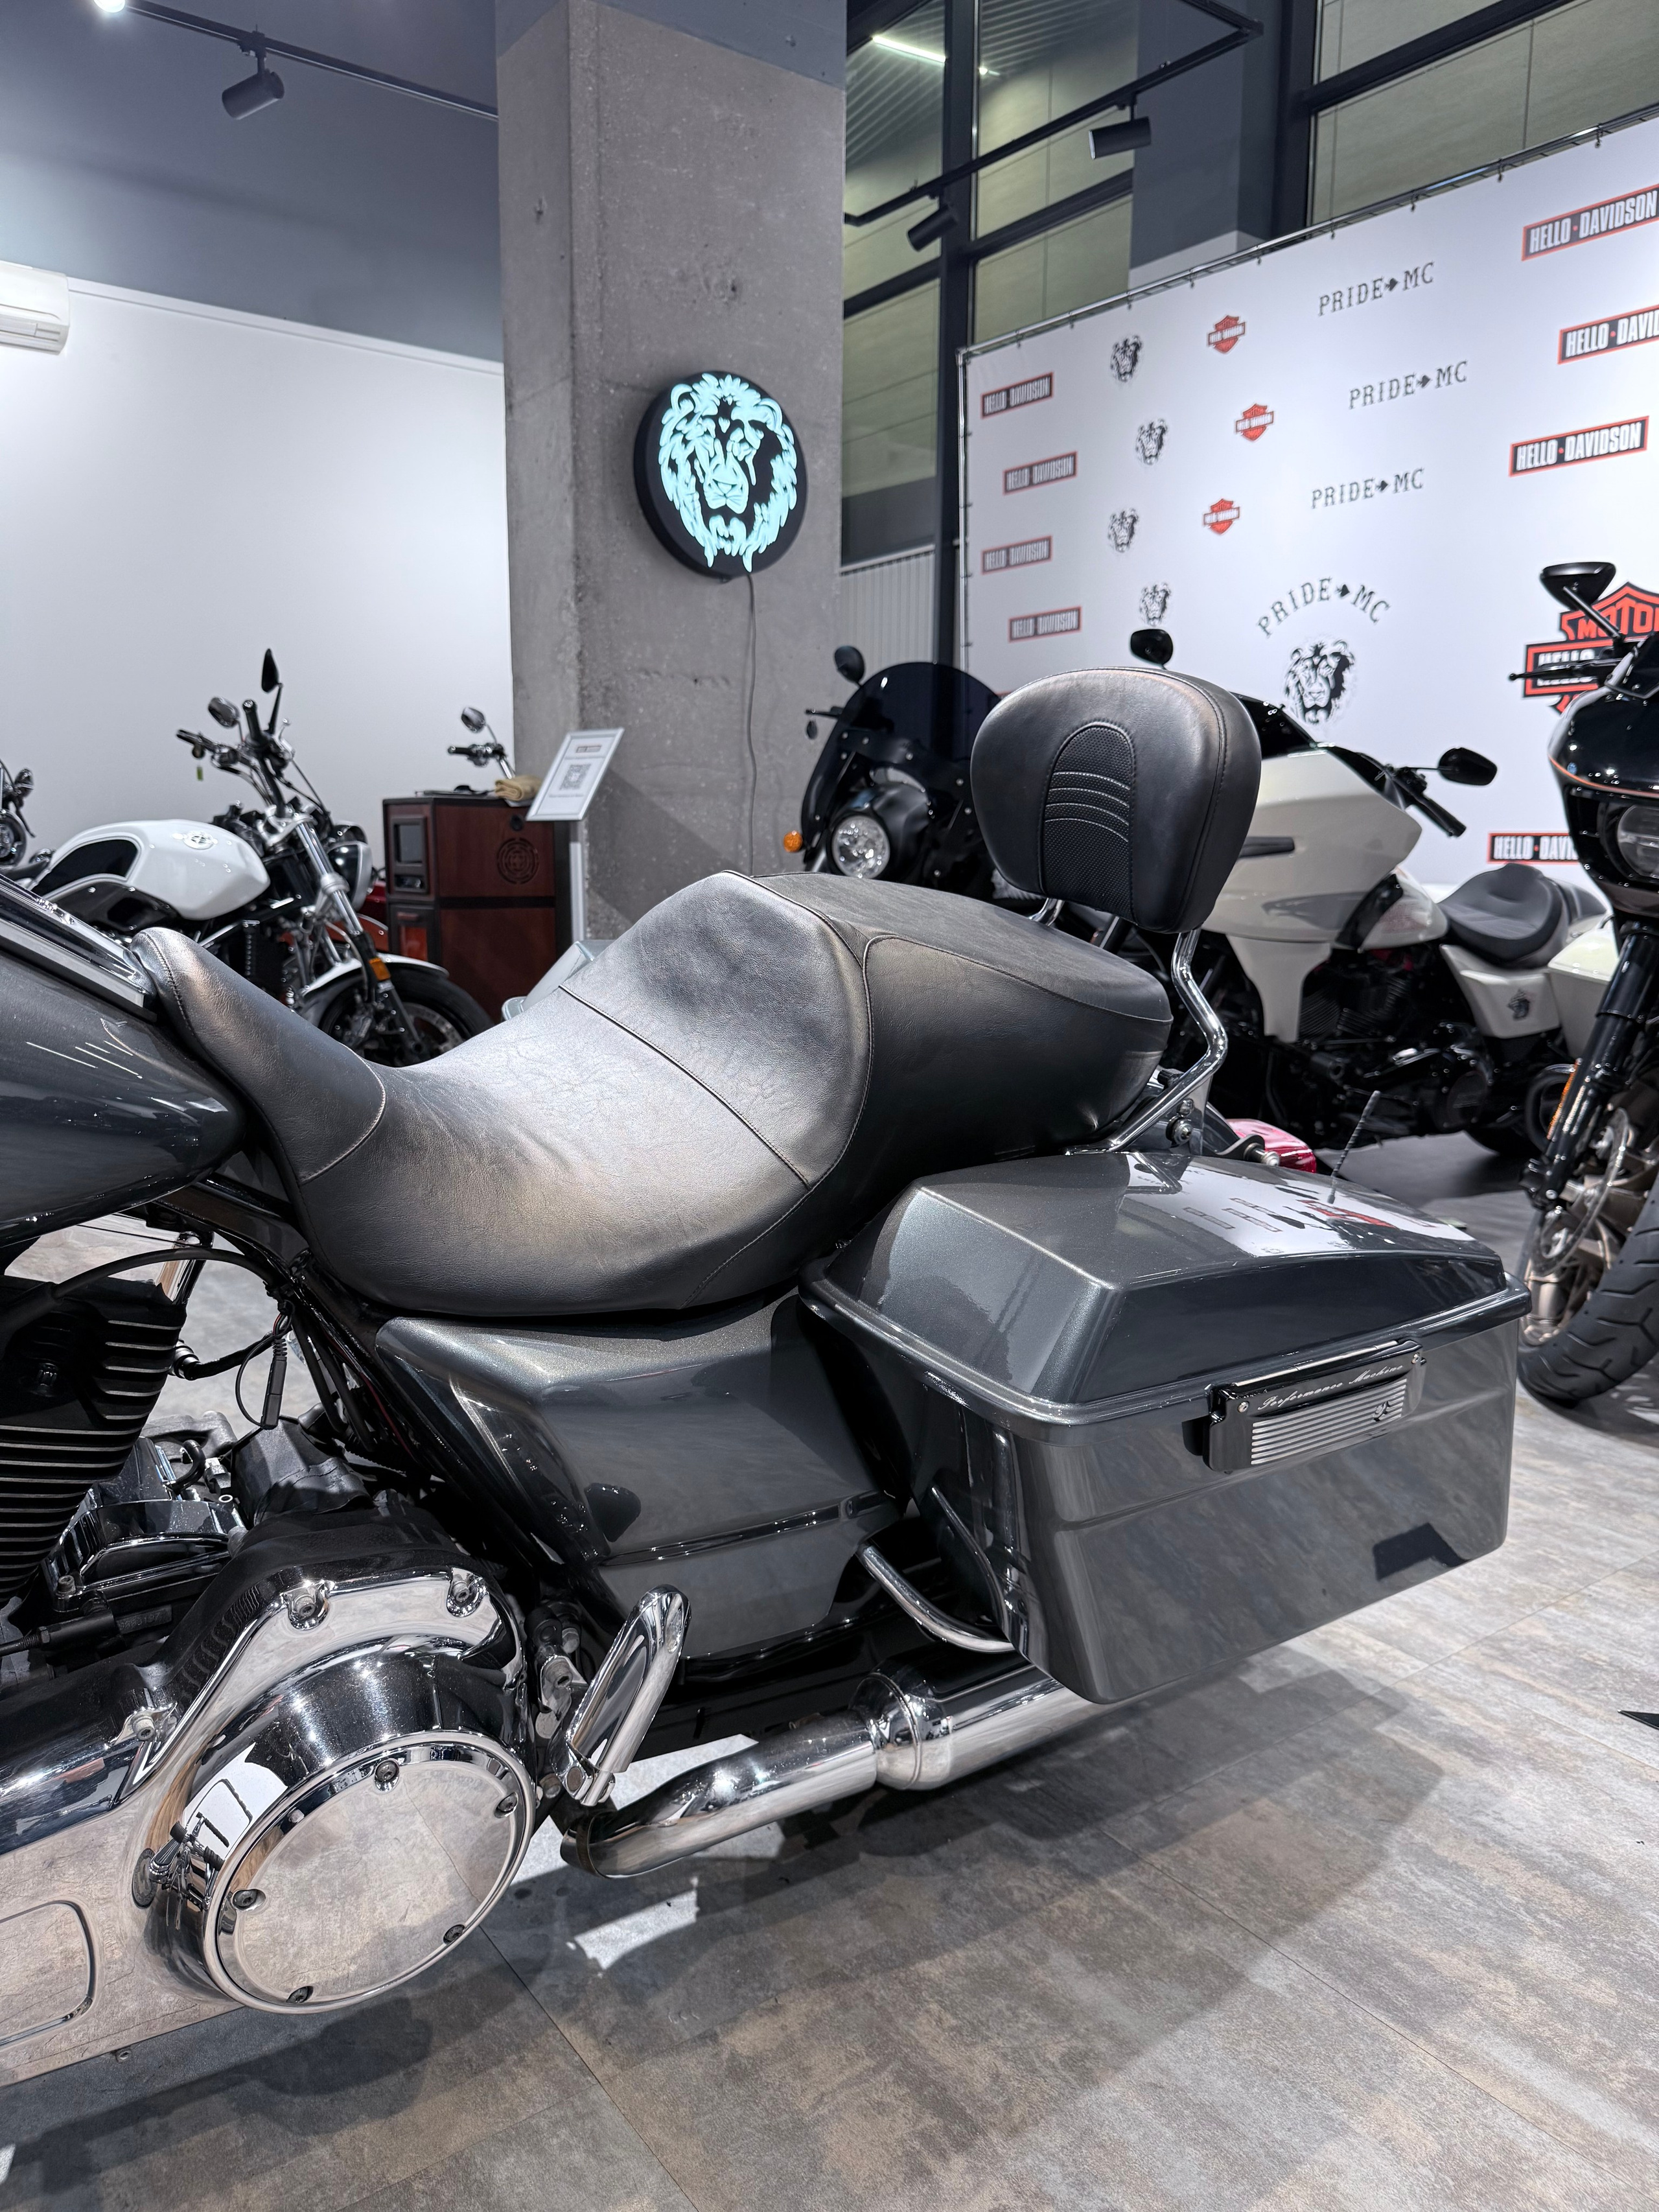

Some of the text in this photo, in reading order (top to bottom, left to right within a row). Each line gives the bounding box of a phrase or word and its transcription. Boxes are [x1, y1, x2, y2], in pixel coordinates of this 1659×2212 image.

[1529, 191, 1658, 253] HELLO DAVIDSON
[1318, 261, 1435, 317] PRIDE MC
[1565, 323, 1610, 358] HELLO
[1349, 360, 1468, 410] PRIDE MC
[1516, 422, 1642, 471] HELLO DAVIDSON
[1311, 467, 1425, 509] PRIDE MC
[1256, 576, 1391, 638] PRIDE MC
[1493, 835, 1534, 859] HELLO
[1257, 1365, 1403, 1410] Performance Machine
